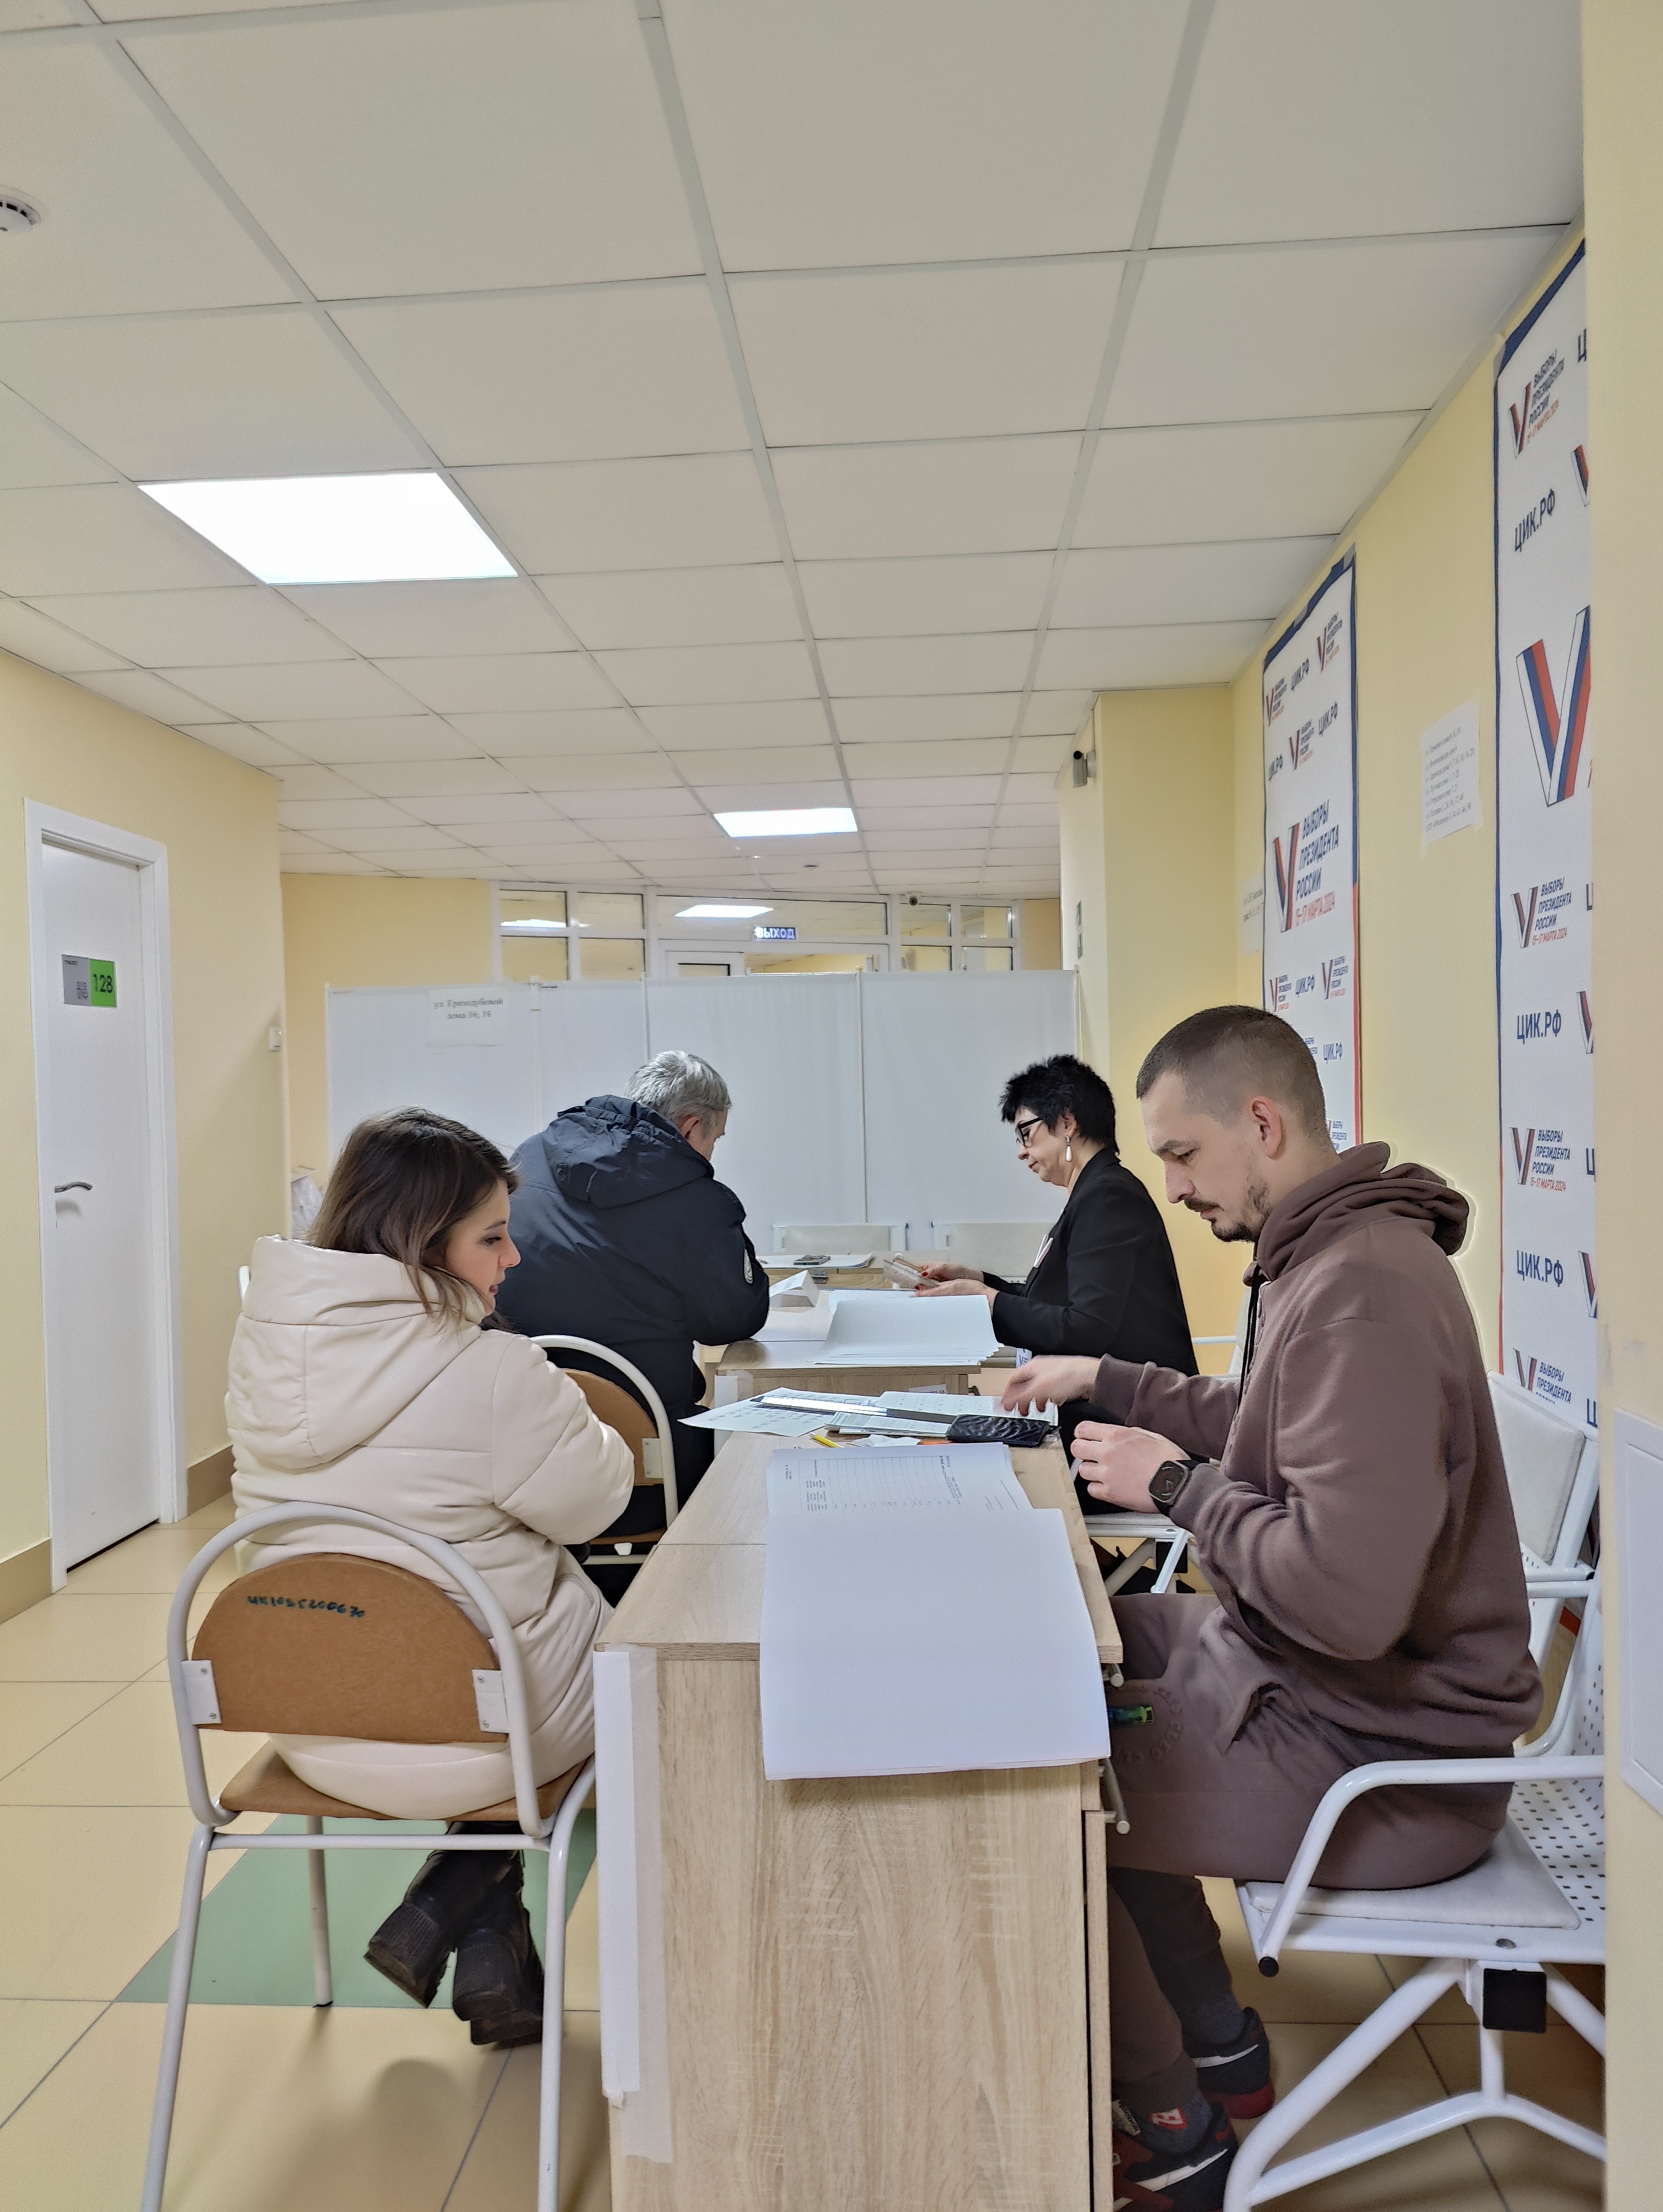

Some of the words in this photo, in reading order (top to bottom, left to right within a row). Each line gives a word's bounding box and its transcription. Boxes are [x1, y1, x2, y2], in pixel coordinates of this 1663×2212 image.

[1515, 488, 1555, 552] ЦИК.РФ
[1302, 799, 1330, 839] ВЫБОРЫ
[1299, 824, 1339, 871] ПРЕЗИДЕНТА
[1296, 867, 1322, 901] РОССИИ
[1540, 877, 1565, 896] ВЫБОРЫ
[1538, 891, 1572, 914] ПРЕЗИДЕНТА
[755, 927, 795, 940] ВЫХОД
[1534, 914, 1557, 931] РОССИИ
[93, 973, 113, 993] 128
[1516, 1009, 1561, 1045] ЦИК.РФ
[1538, 1129, 1563, 1142] ВЫБОРЫ
[1535, 1145, 1570, 1161] ПРЕЗИДЕНТА
[1531, 1161, 1555, 1175] РОССИИ
[1516, 1250, 1563, 1287] ЦИК.РФ
[1539, 1361, 1565, 1383] ВЫБОРЫ
[1536, 1377, 1572, 1404] ПРЕЗИДЕНТА
